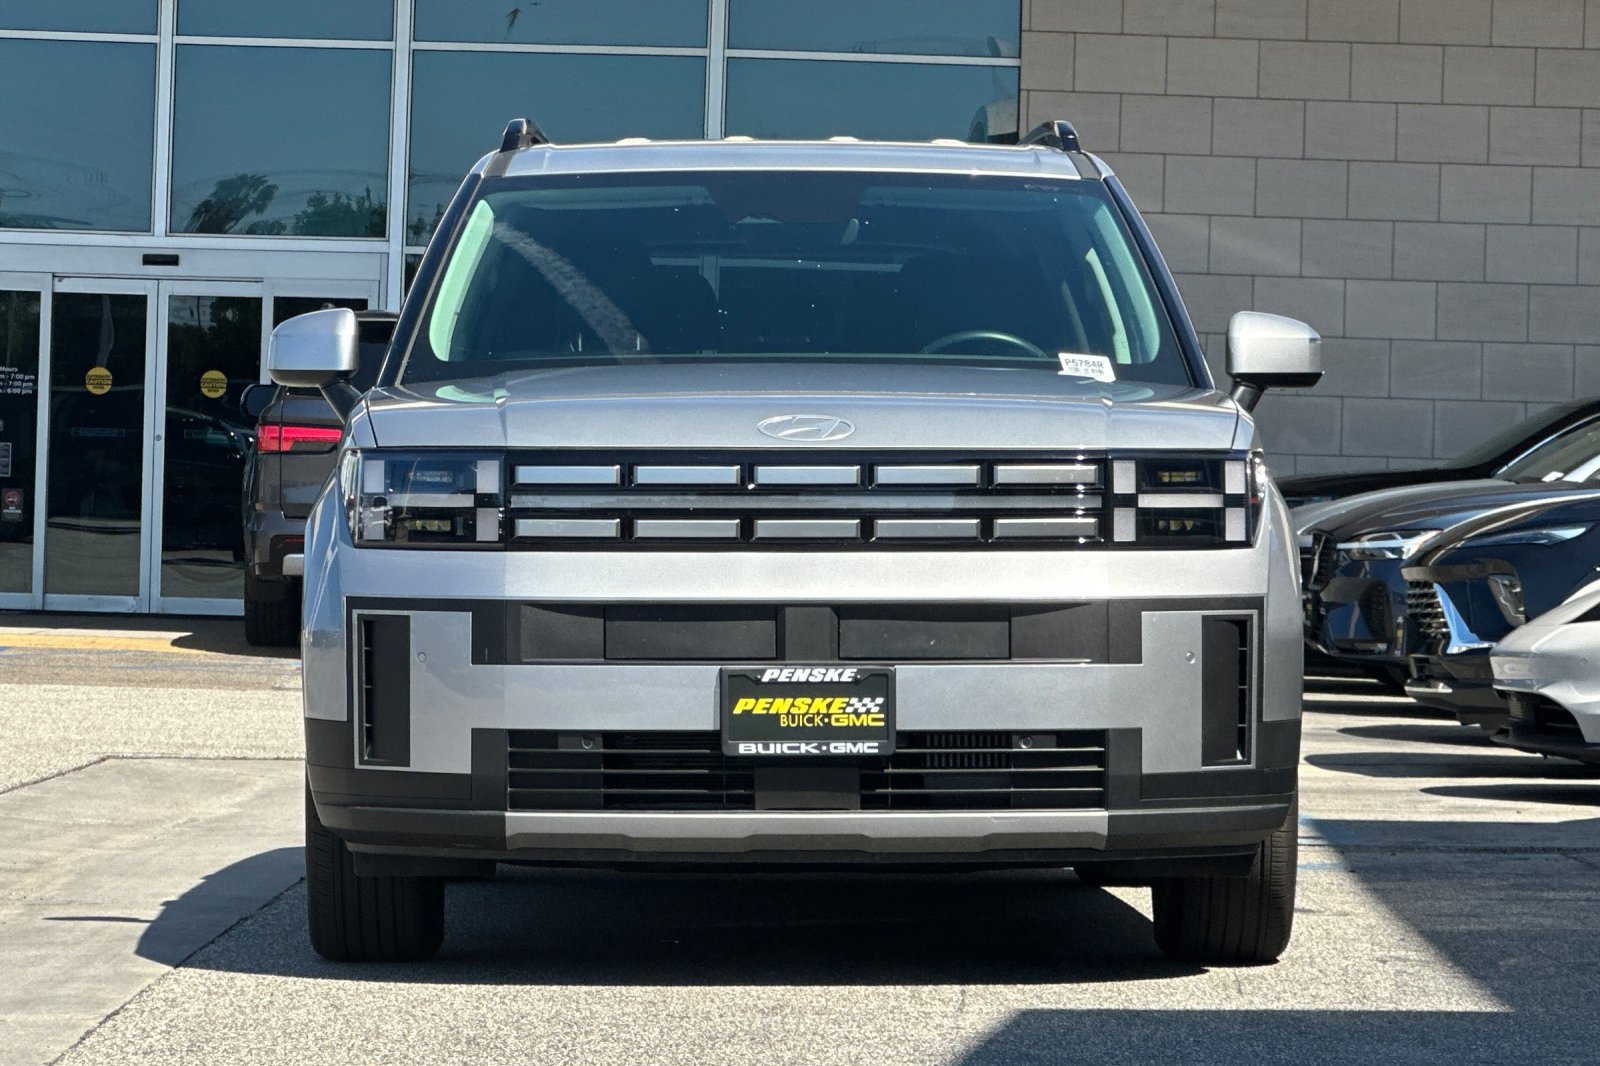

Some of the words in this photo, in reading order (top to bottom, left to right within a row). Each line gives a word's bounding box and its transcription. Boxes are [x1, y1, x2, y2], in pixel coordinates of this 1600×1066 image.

[1064, 358, 1104, 369] P5784R
[761, 668, 858, 682] PENSKE
[732, 697, 850, 715] PENSKE
